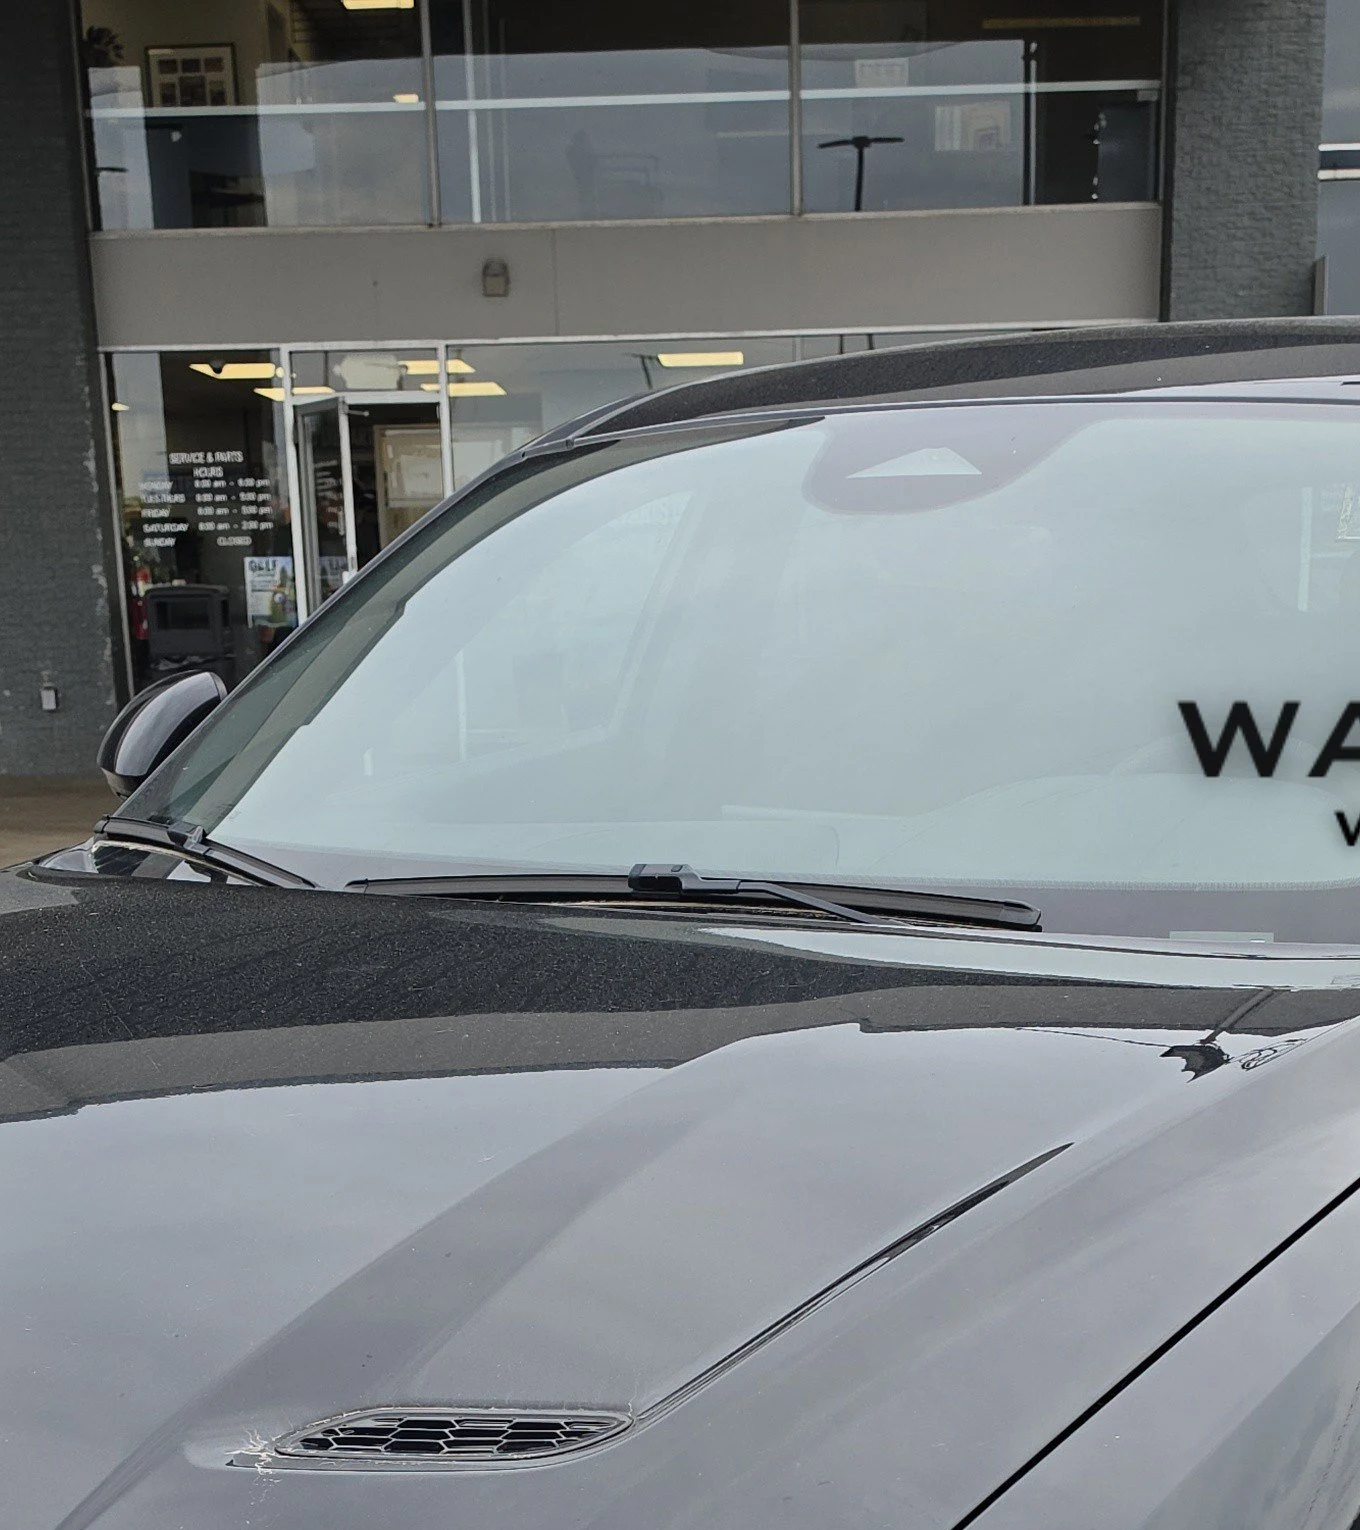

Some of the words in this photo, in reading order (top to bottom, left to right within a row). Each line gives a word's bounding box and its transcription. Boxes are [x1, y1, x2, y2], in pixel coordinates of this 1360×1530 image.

[169, 452, 205, 464] SERVICE
[206, 452, 214, 463] &
[215, 451, 243, 463] PARTS
[193, 466, 223, 478] HOURS
[141, 508, 170, 518] FRIDAY
[143, 523, 189, 533] SATURDAY
[143, 538, 176, 547] SUNDAY
[217, 537, 252, 546] CLOSED
